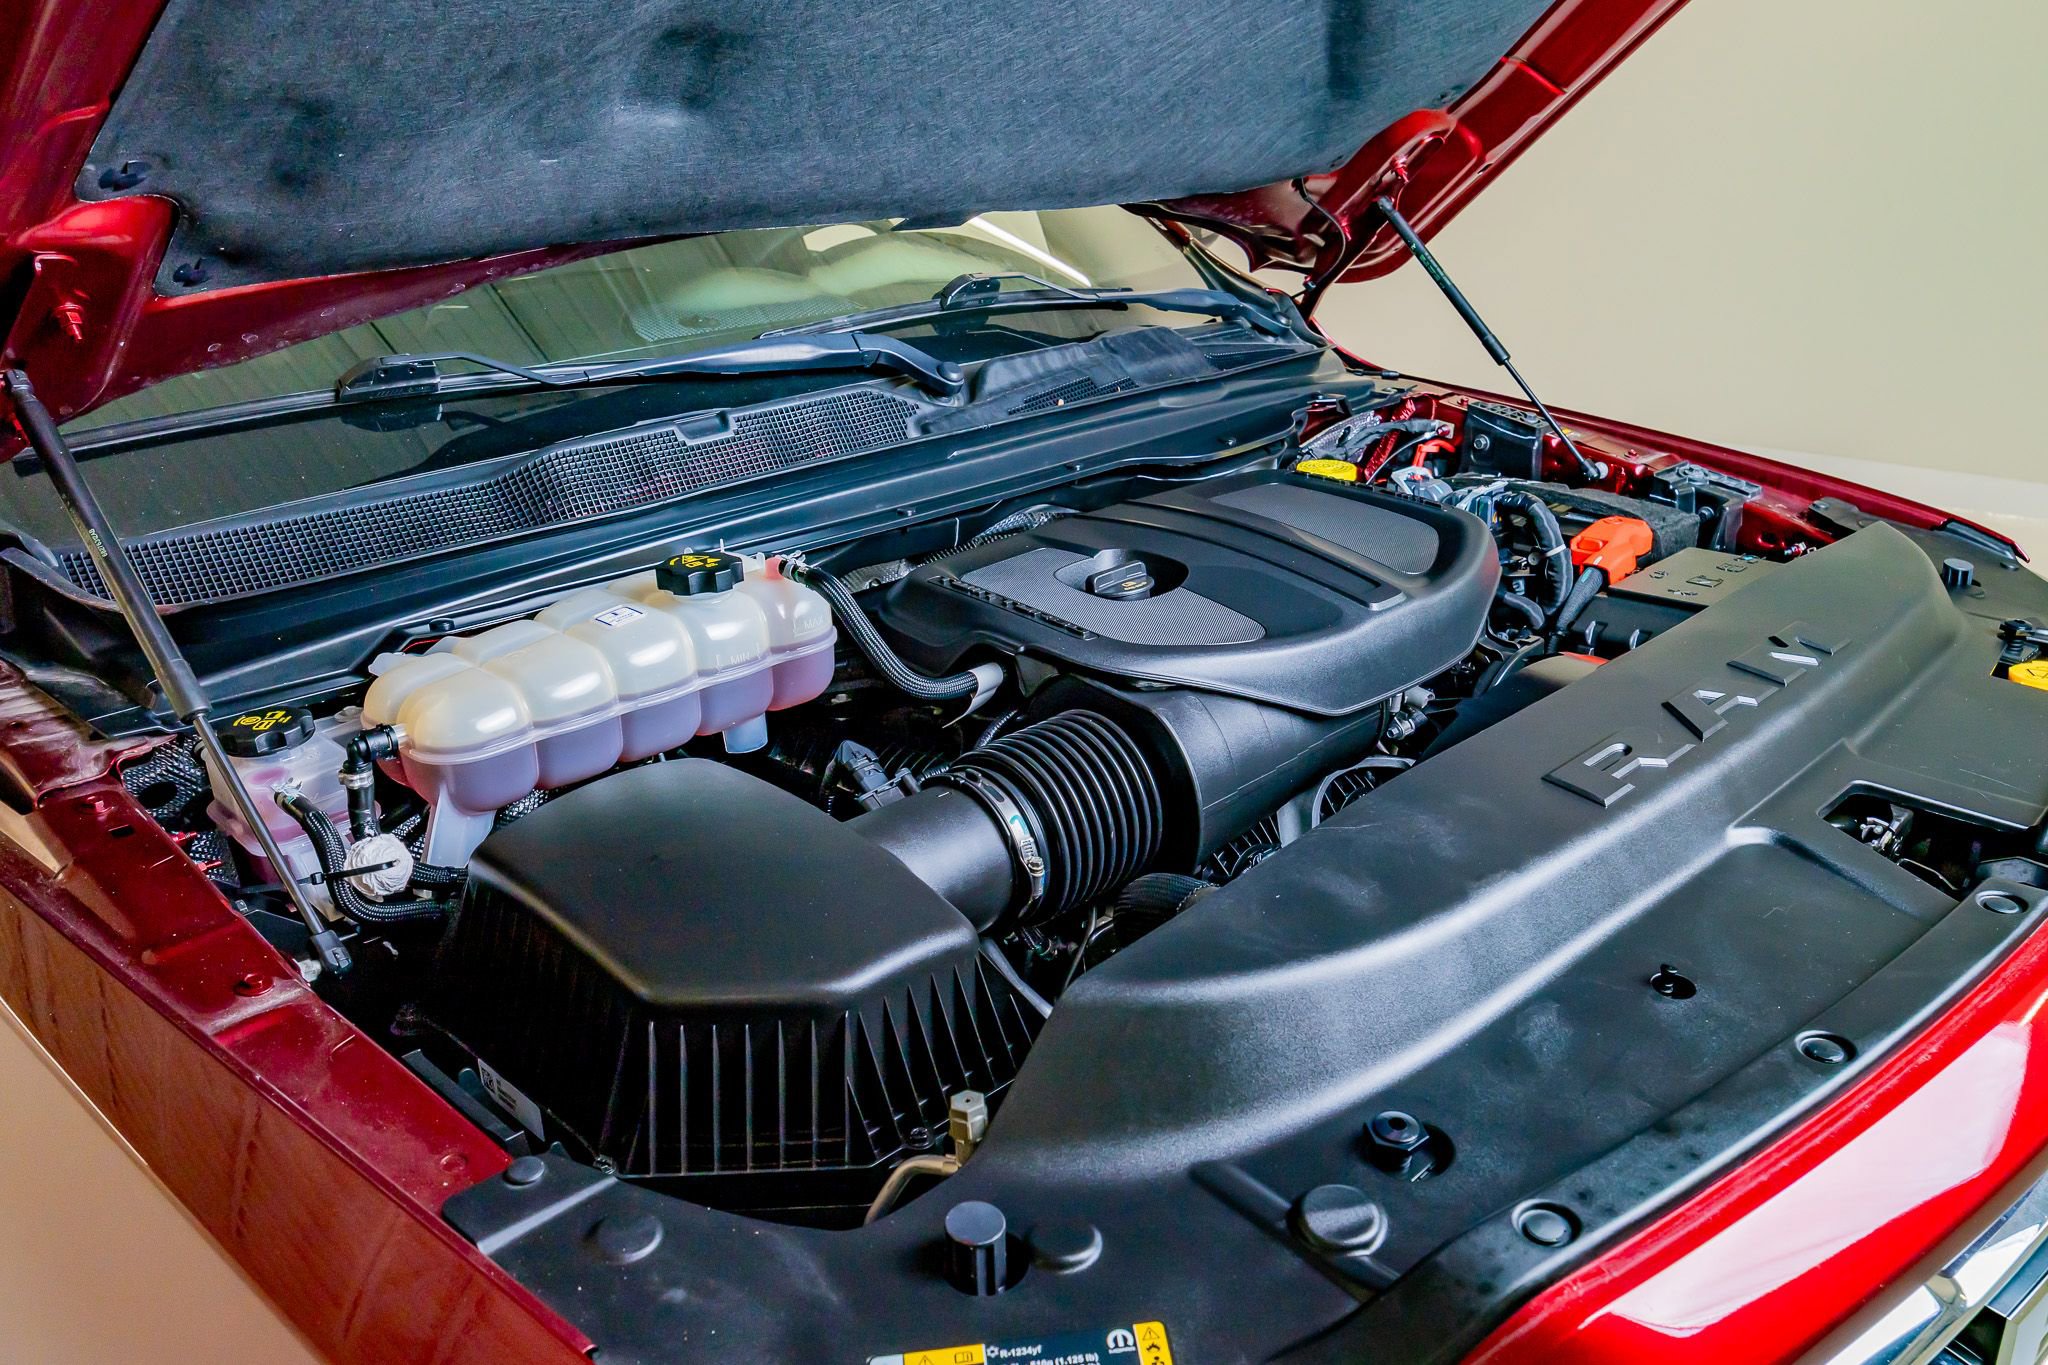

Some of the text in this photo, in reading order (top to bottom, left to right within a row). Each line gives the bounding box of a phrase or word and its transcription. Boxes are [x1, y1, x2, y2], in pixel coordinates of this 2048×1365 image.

[804, 615, 823, 629] MAX
[730, 652, 751, 664] MIN
[1541, 621, 1851, 808] RAM
[1000, 1344, 1042, 1358] R-1234yf
